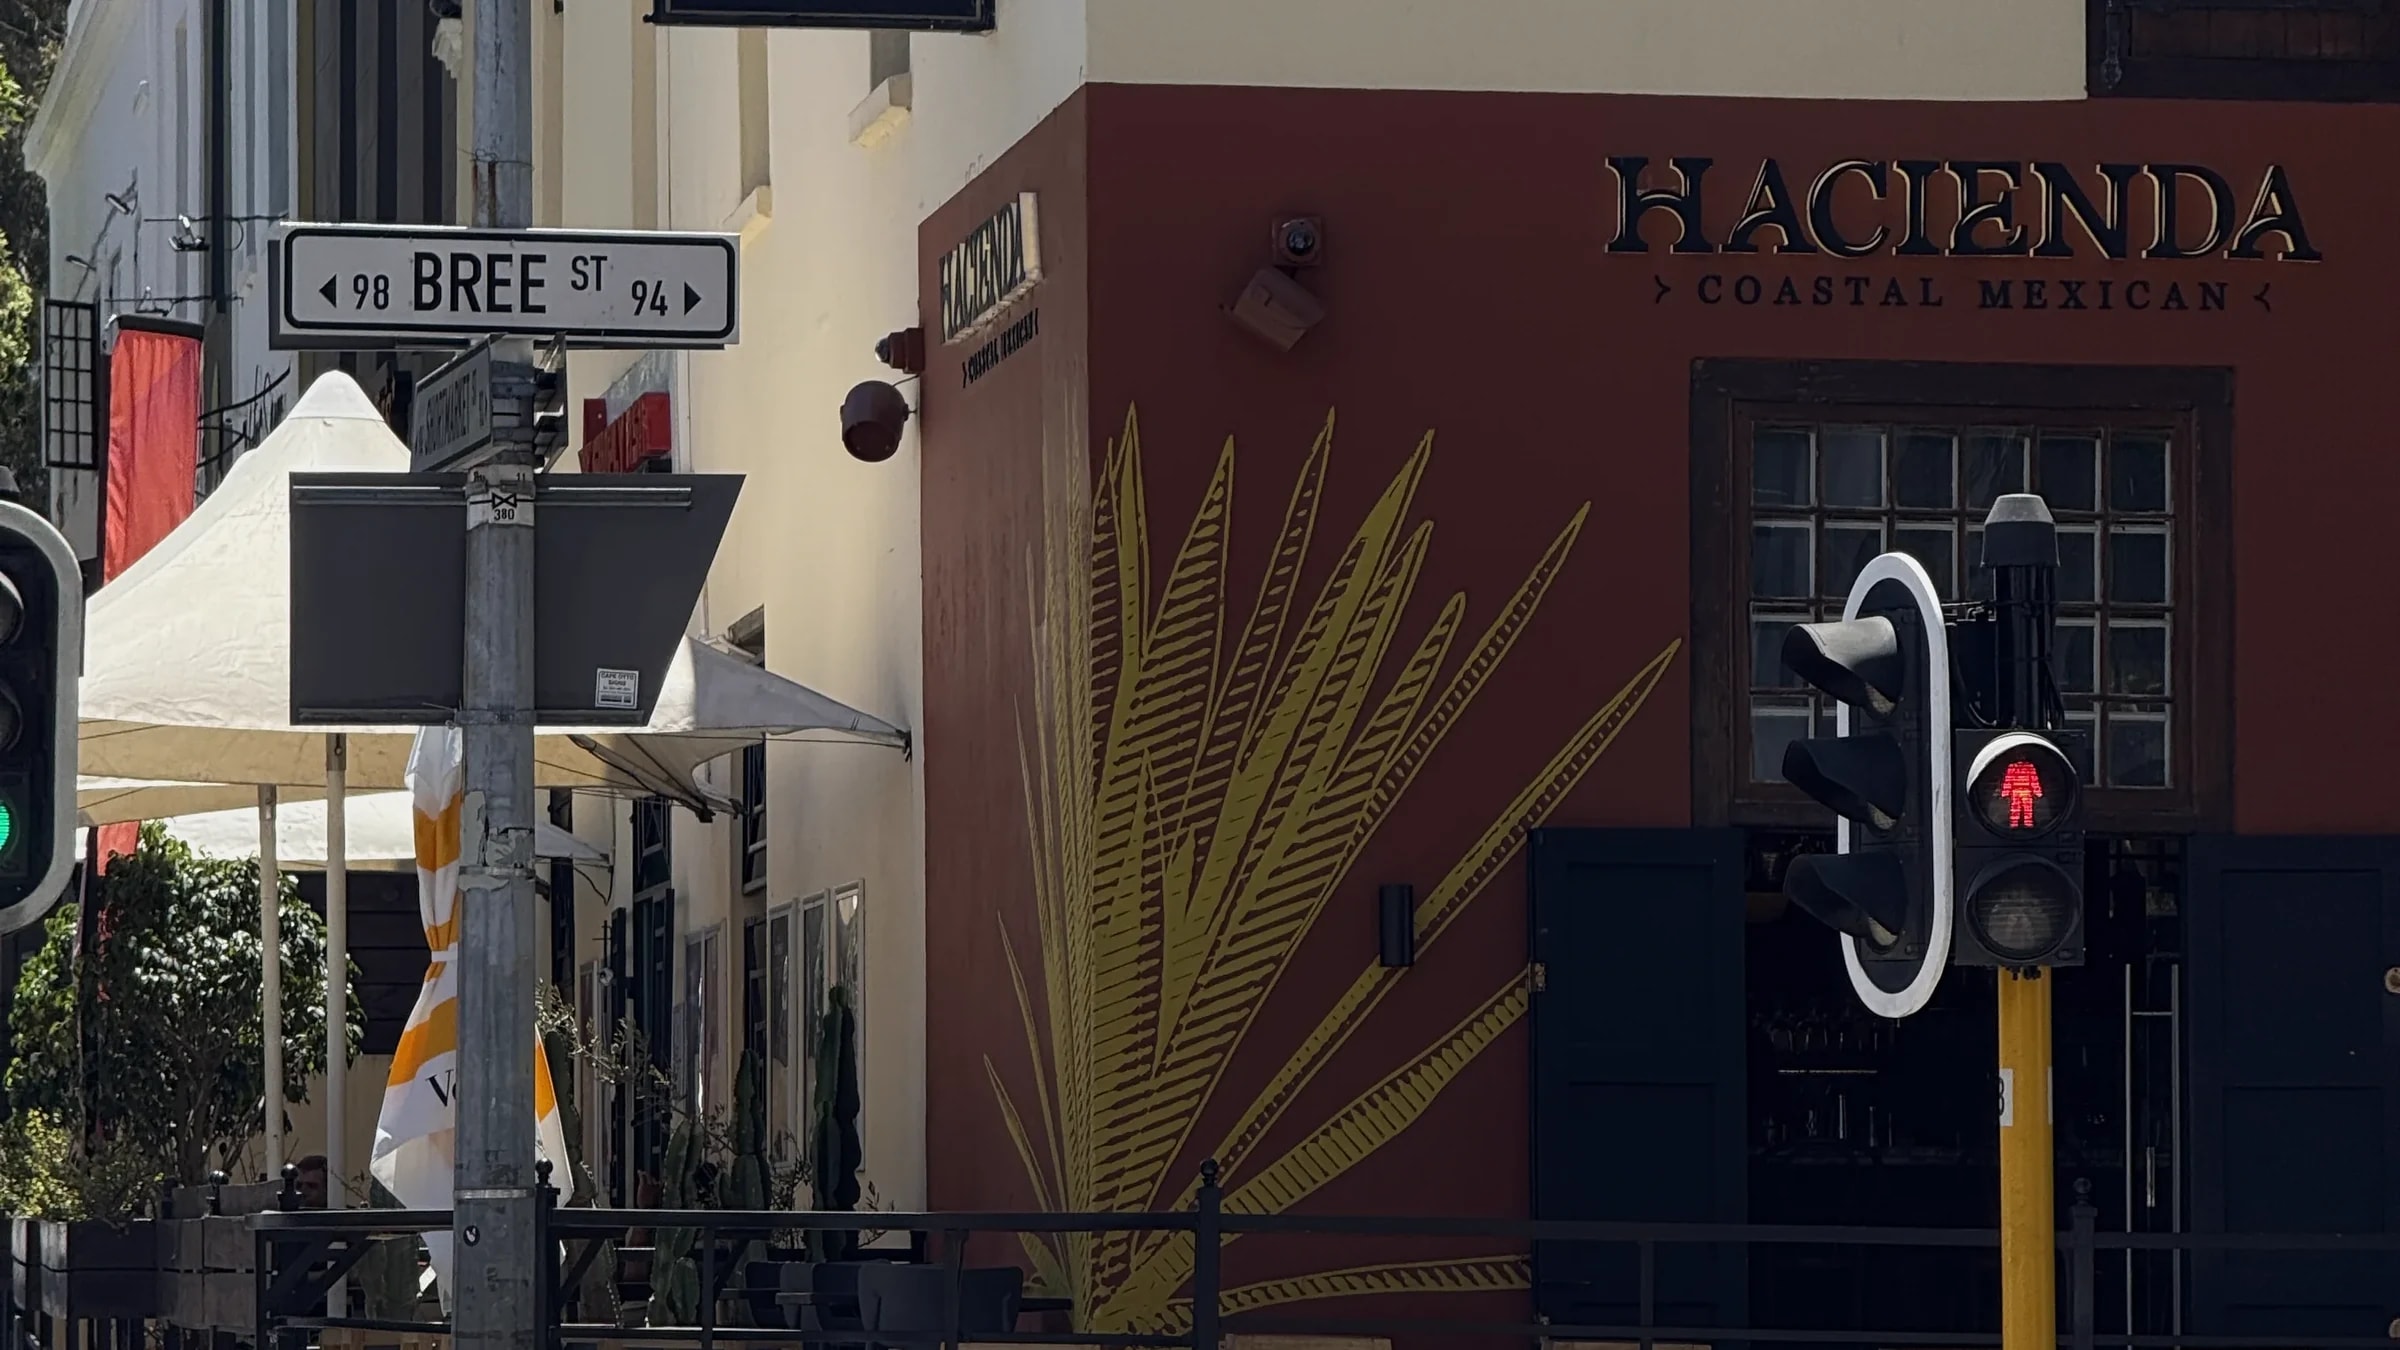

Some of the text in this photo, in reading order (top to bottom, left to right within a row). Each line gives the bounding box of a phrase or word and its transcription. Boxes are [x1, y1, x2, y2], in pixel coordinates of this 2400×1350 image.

[1605, 157, 2322, 263] HACIENDA
[353, 252, 668, 316] 98 BREE ST 94
[938, 201, 1026, 344] HACIENDA
[1698, 275, 2228, 310] COASTAL MEXICAN
[494, 508, 515, 520] 380
